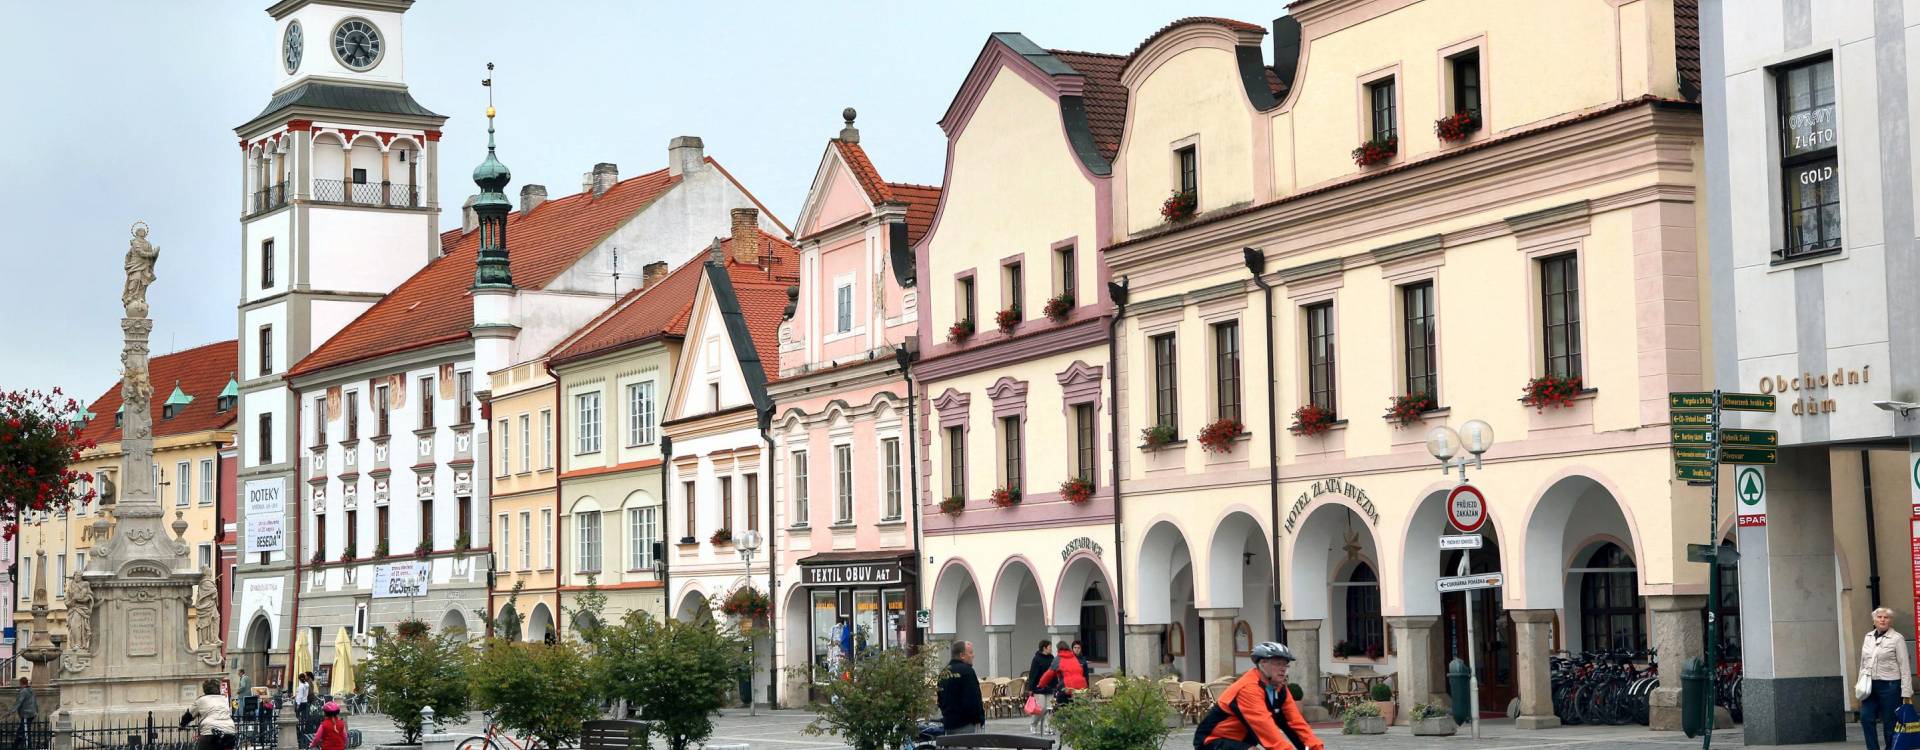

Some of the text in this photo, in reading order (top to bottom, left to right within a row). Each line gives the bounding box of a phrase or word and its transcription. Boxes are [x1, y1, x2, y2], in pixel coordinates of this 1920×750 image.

[1795, 128, 1833, 149] ZLATO
[1800, 166, 1832, 185] GOLD
[1759, 365, 1869, 394] Obchodní
[250, 488, 280, 502] DOTEKY
[1284, 476, 1380, 534] HOTEL ZLATÁ HVĚZDA
[1456, 499, 1478, 509] PRŮJEZD
[1739, 516, 1766, 525] SPAR
[256, 535, 277, 548] BESEDA
[1061, 536, 1103, 562] RESTAURACE
[811, 566, 890, 582] TEXTIL OBUV A&T
